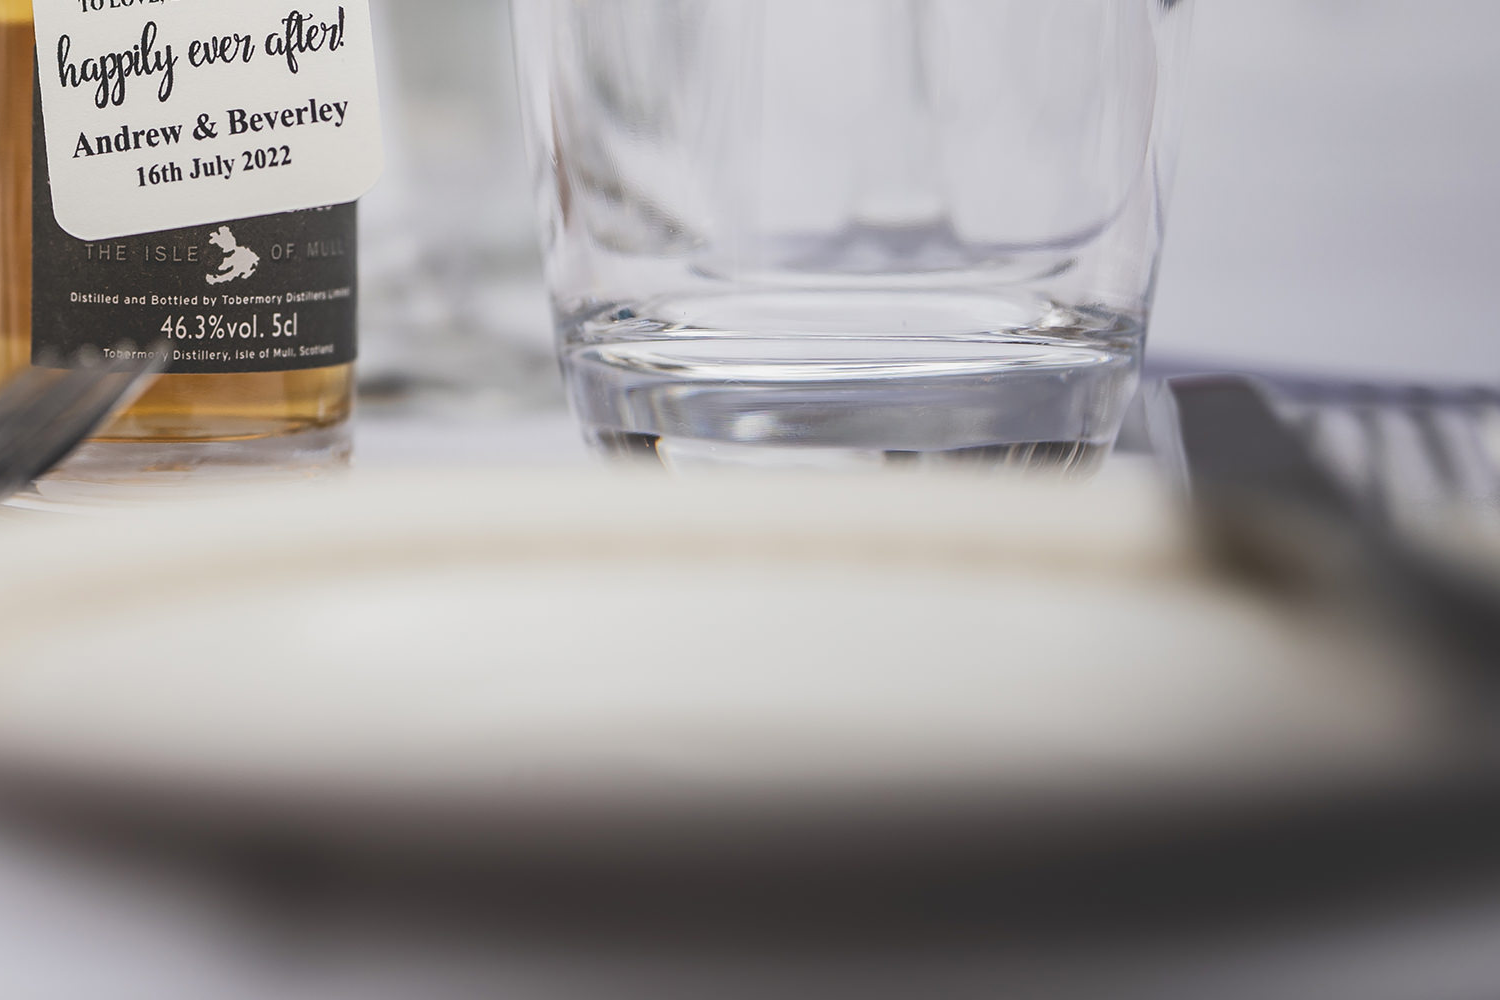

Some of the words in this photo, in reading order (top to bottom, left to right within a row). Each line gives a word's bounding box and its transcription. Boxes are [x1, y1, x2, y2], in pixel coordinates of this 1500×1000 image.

[57, 21, 178, 109] happily
[188, 33, 255, 67] ever
[265, 6, 345, 74] after!
[72, 124, 182, 158] Andrew
[192, 113, 218, 141] &
[226, 99, 349, 136] Beverley
[136, 160, 183, 187] 16th
[189, 154, 235, 181] July
[243, 145, 292, 171] 2022
[84, 243, 127, 261] THE
[145, 245, 199, 262] ISLE
[271, 243, 295, 260] OF
[70, 291, 119, 305] Distilled
[124, 295, 146, 305] and
[151, 294, 198, 306] Bottled
[202, 295, 217, 307] by
[221, 294, 283, 306] Tobermory
[272, 312, 297, 338] 5cl
[103, 348, 169, 362] Tobermoy
[173, 349, 231, 362] Distillery,
[235, 349, 255, 359] Isle
[259, 347, 270, 359] of
